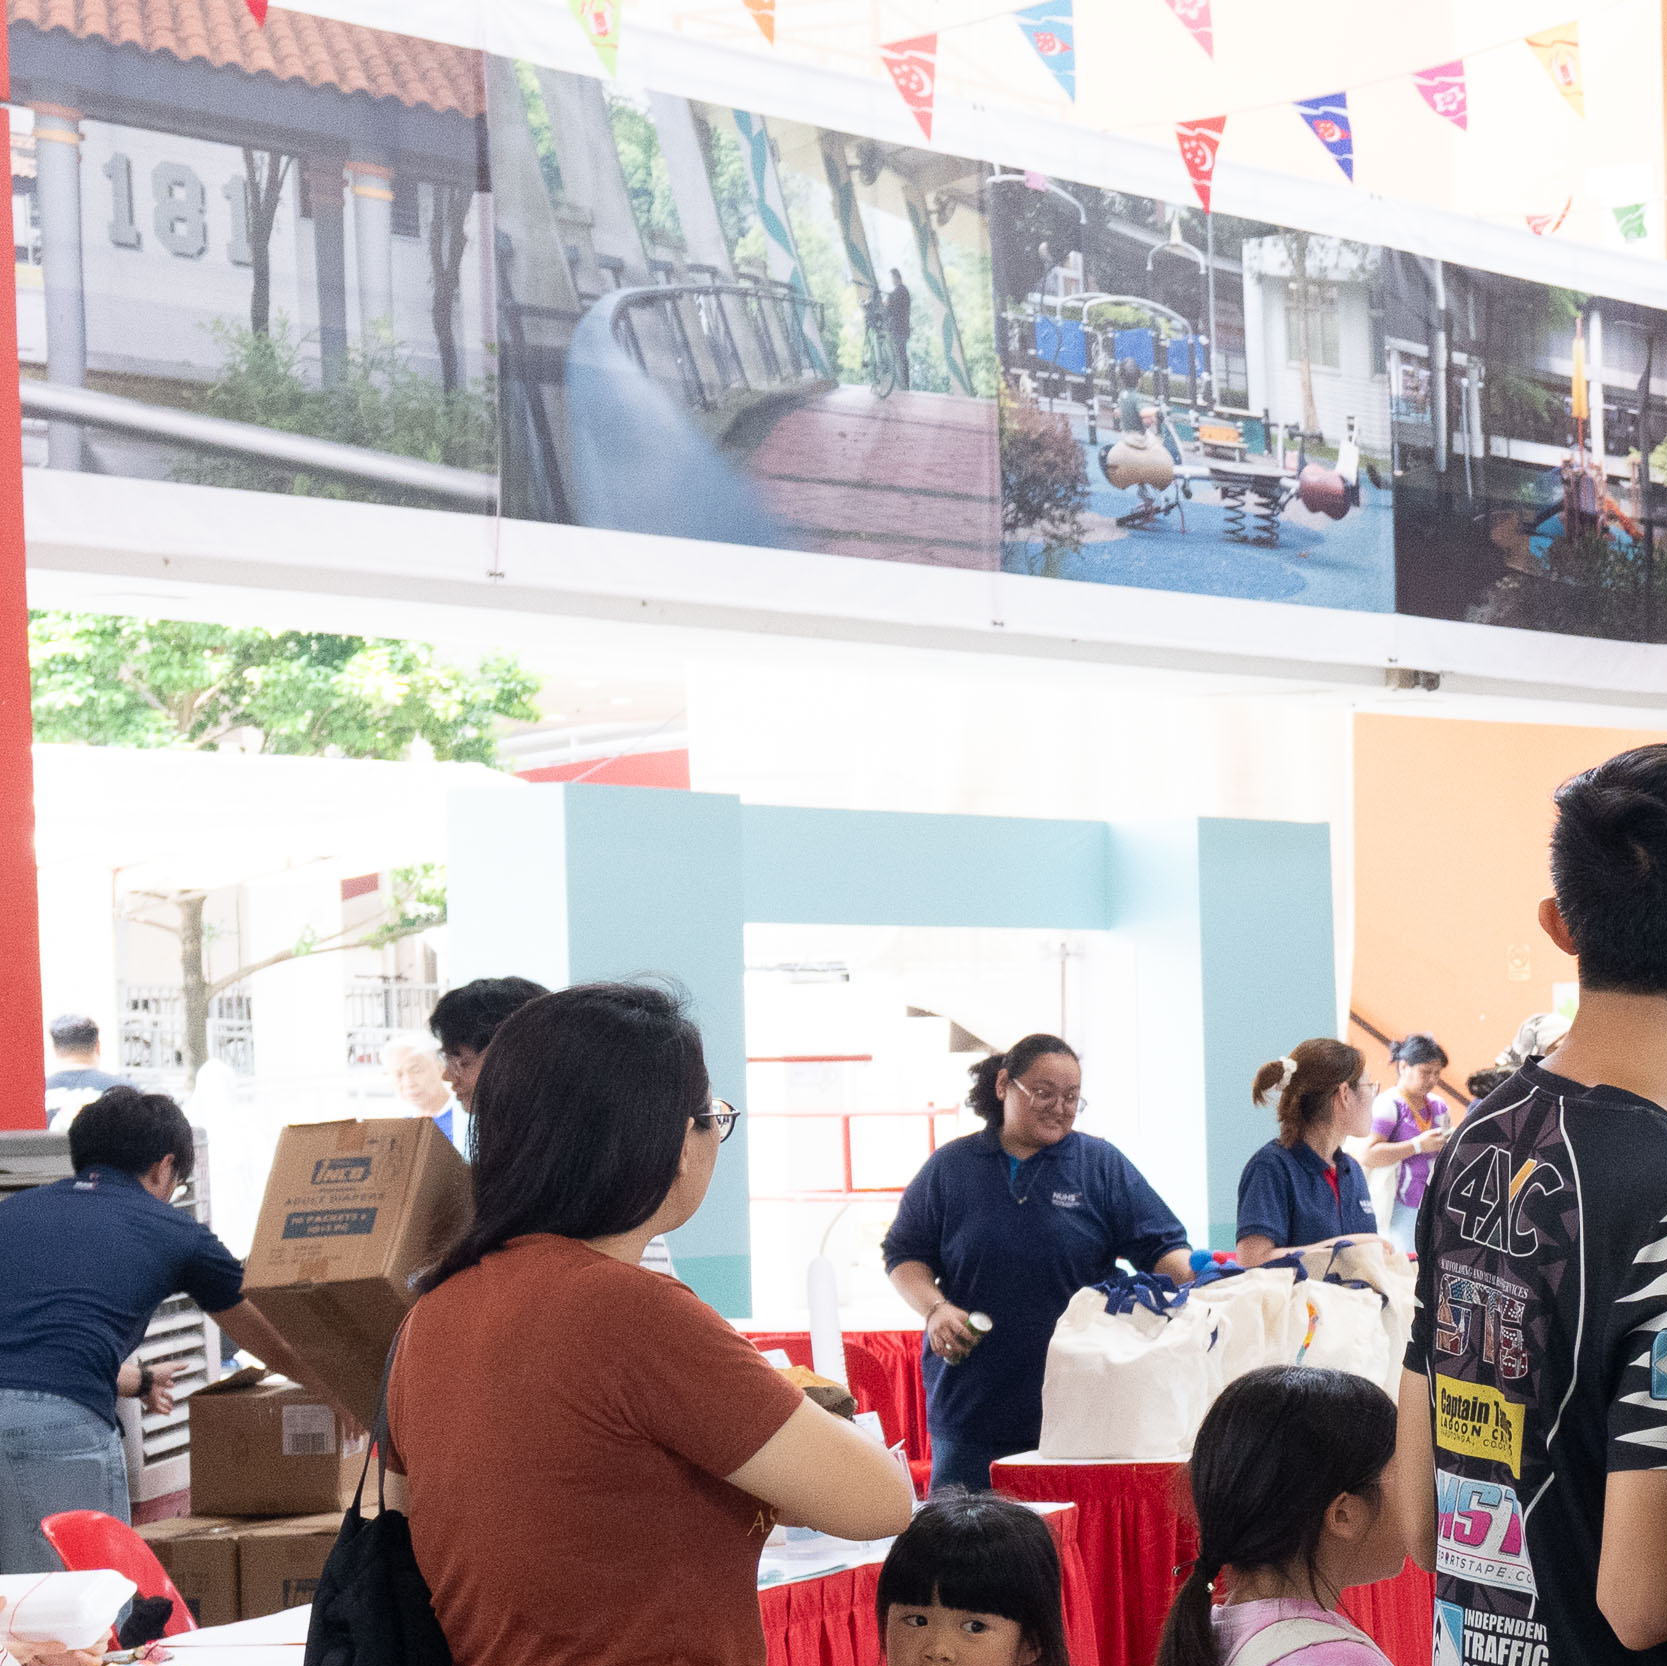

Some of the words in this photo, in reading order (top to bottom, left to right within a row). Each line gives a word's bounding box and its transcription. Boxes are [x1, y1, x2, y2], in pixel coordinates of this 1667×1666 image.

[1474, 1267, 1484, 1280] AND
[1441, 1387, 1490, 1425] Captain
[1440, 1415, 1482, 1437] LAGOON
